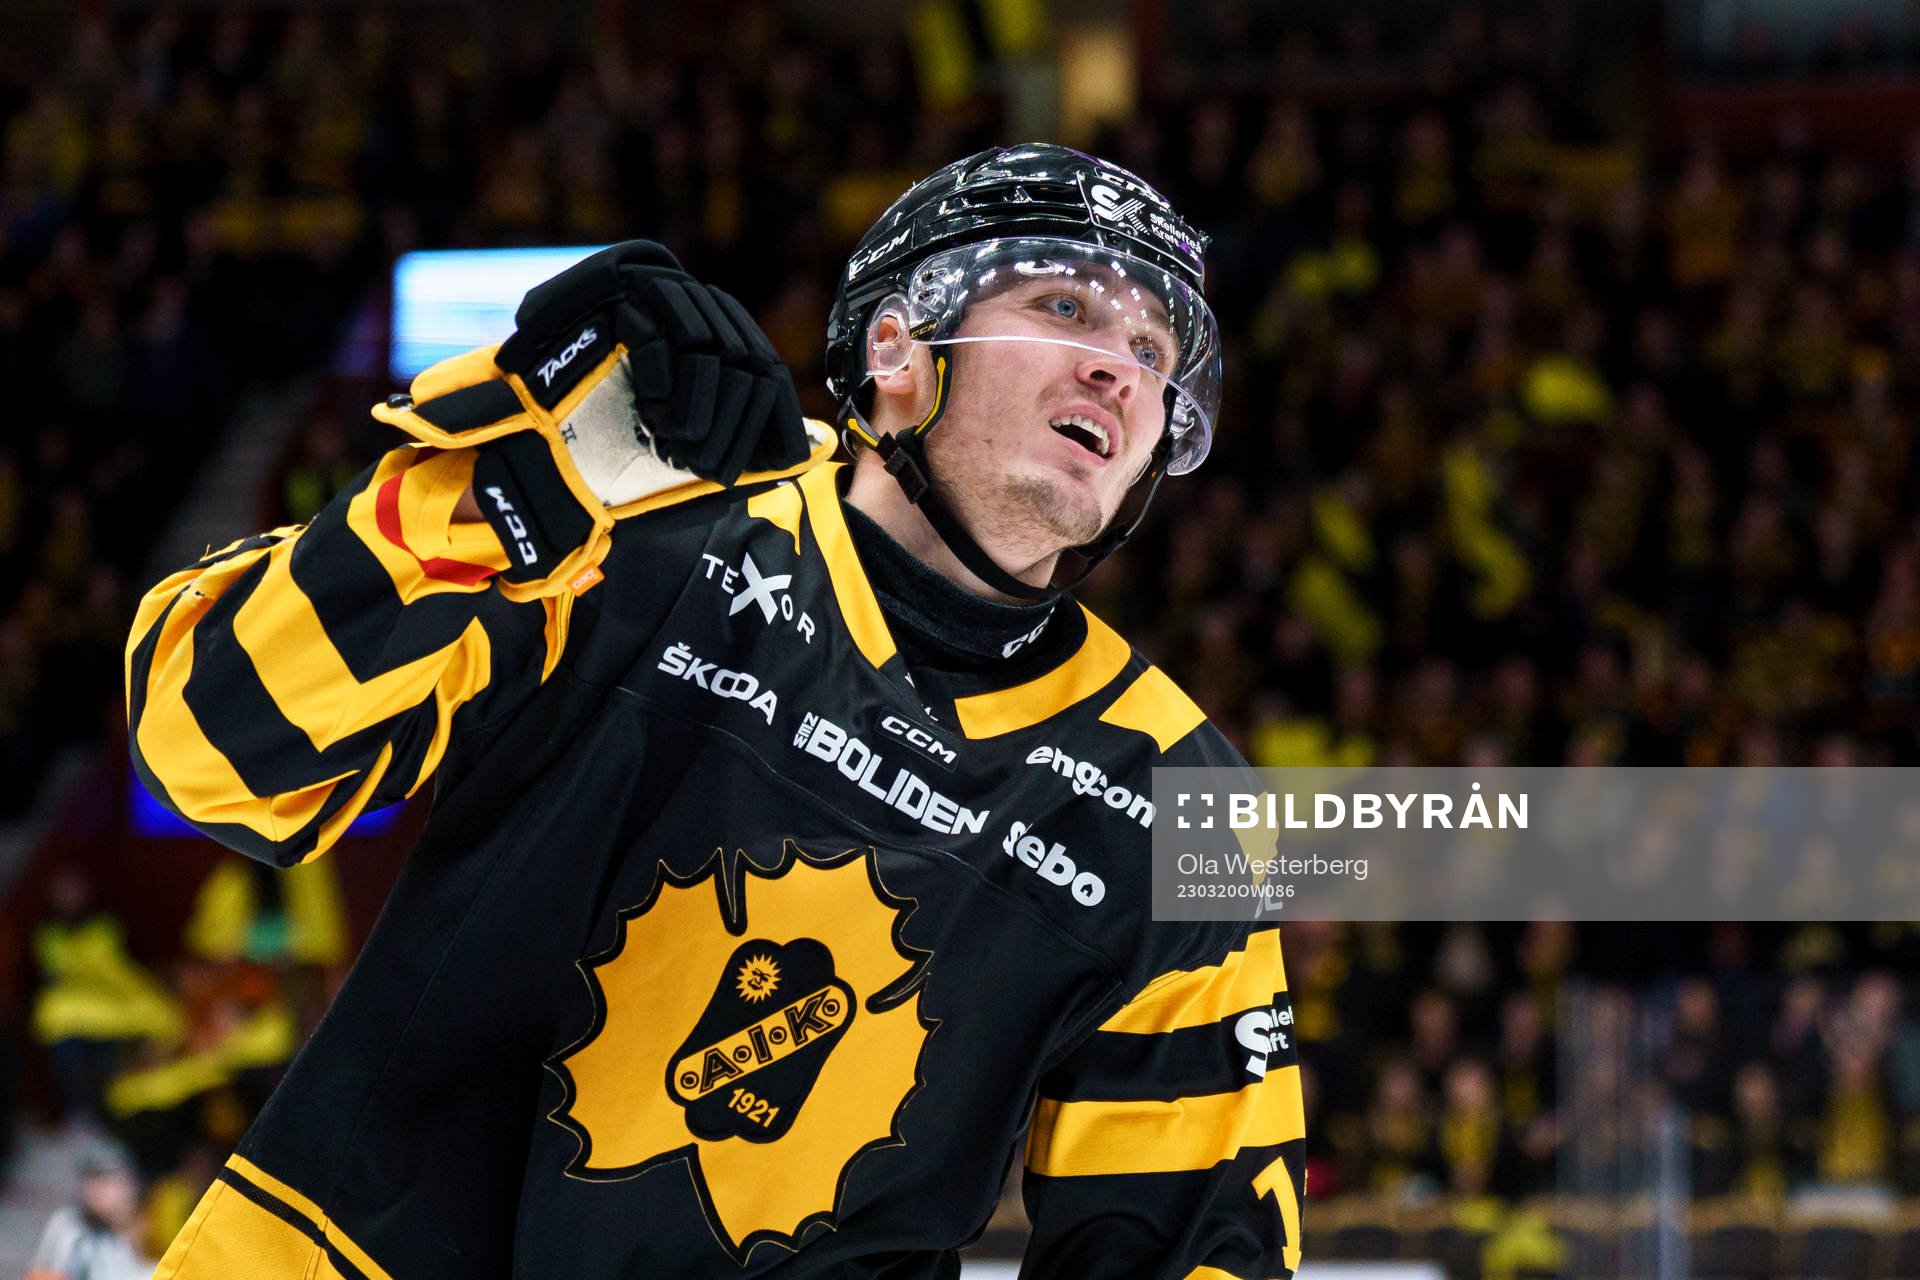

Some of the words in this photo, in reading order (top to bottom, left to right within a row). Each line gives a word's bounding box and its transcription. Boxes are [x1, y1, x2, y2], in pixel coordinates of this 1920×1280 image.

[850, 228, 911, 281] CCM
[537, 327, 597, 387] TACKS
[485, 486, 538, 566] CCM
[1002, 606, 1055, 659] CC
[881, 715, 957, 764] CCM
[805, 718, 990, 835] BOLIDEN
[1026, 745, 1157, 829] engcon
[728, 1088, 780, 1128] 1921
[1251, 1156, 1304, 1272] 1
